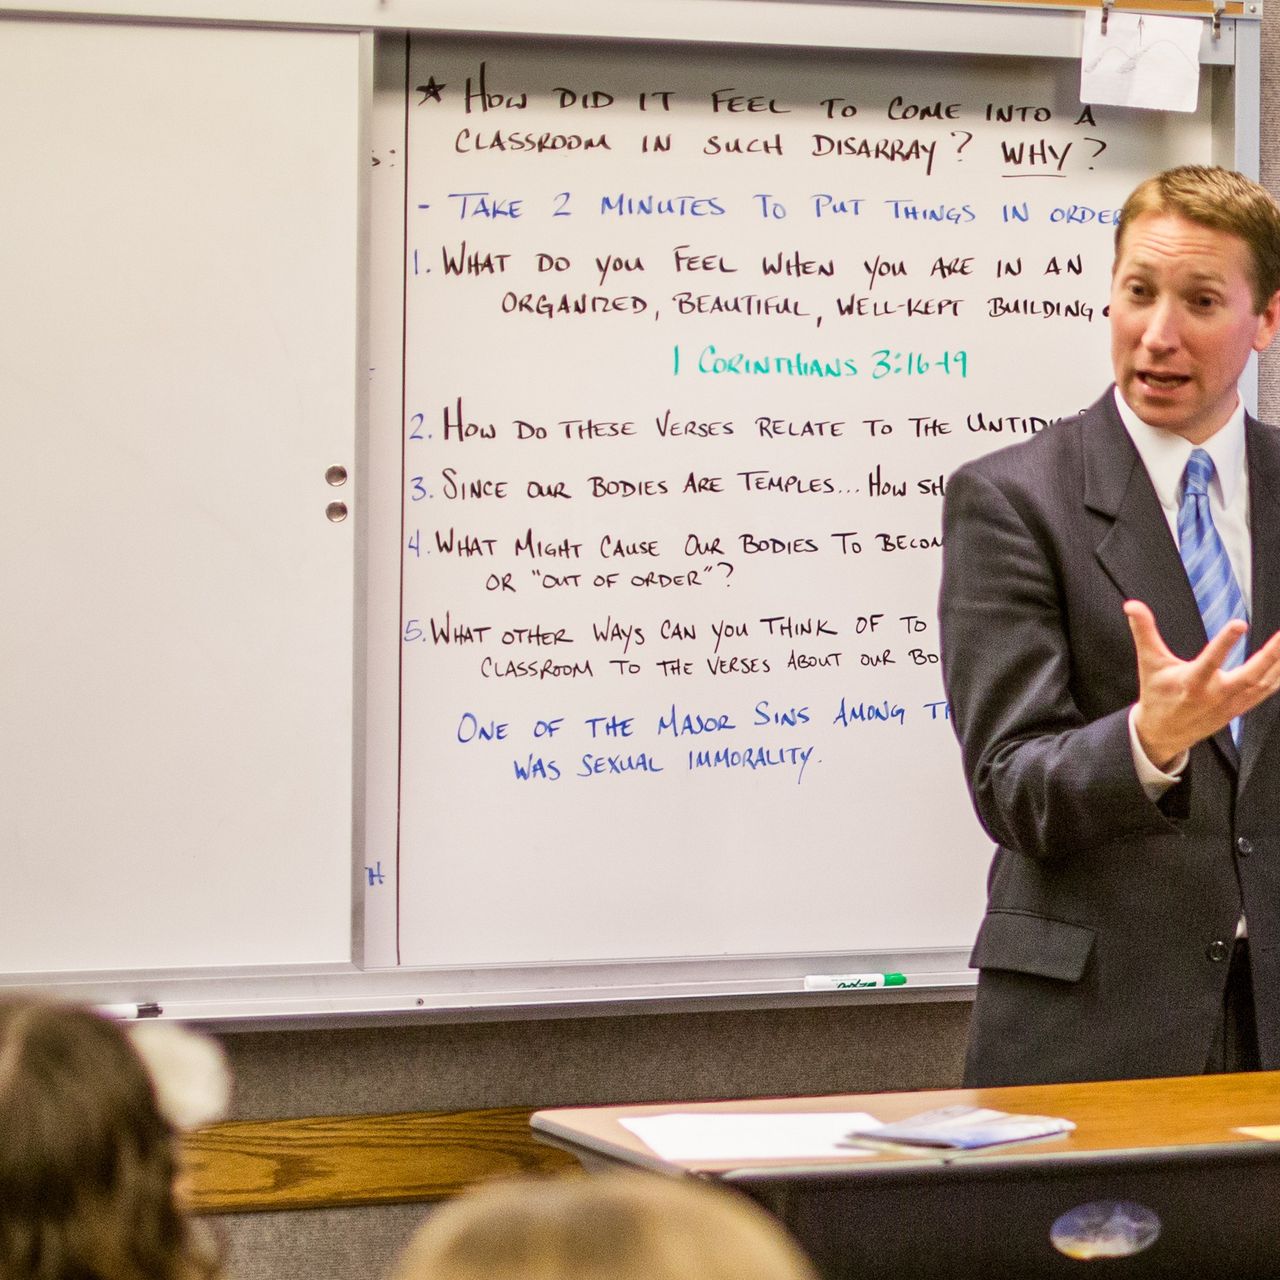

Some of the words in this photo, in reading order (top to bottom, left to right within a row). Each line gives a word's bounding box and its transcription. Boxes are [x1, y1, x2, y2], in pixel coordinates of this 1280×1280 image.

[464, 61, 528, 115] HOW
[551, 87, 614, 110] DID
[638, 91, 676, 112] IT
[711, 87, 792, 114] FEEL
[819, 97, 858, 120] TO
[887, 95, 962, 121] COME
[985, 103, 1052, 124] INTO
[1075, 104, 1096, 127] A
[454, 127, 612, 154] CLASSROOM
[641, 133, 672, 154] IN
[702, 133, 784, 156] SUCH
[447, 192, 523, 220] TAKE
[553, 191, 572, 217] 2
[600, 192, 726, 217] MINUTES
[753, 194, 786, 220] TO
[812, 193, 865, 218] PUT
[884, 200, 976, 225] THINGS
[1002, 202, 1030, 223] IN
[1049, 205, 1121, 226] ORDER
[441, 239, 512, 277] WHAT
[535, 252, 571, 273] DO
[594, 254, 645, 287] YOU
[672, 244, 738, 274] FEEL
[761, 250, 835, 279] WHEN
[863, 254, 908, 292] YOU
[929, 256, 976, 280] ARE
[996, 256, 1023, 279] IN
[1043, 253, 1083, 276] AN
[501, 291, 660, 322] ORGANIZED,
[671, 291, 823, 329] BEAUTIFUL,
[835, 292, 965, 318] WELL-KEPT
[697, 344, 858, 379] CORINTHIANS
[871, 348, 968, 380] 3:16-19
[409, 412, 433, 440] 2.
[443, 396, 497, 443] HOW
[511, 419, 548, 440] DO
[557, 418, 638, 440] THESE
[655, 408, 735, 438] VERSES
[754, 416, 846, 440] RELATE
[861, 418, 893, 438] TO
[907, 416, 953, 438] THE
[410, 475, 434, 502] 3.
[441, 467, 509, 501] SINCE
[526, 480, 573, 500] OUR
[586, 475, 669, 499] BODIES
[682, 471, 725, 494] ARE
[868, 463, 907, 498] HOW
[408, 529, 431, 558] 4.
[434, 526, 498, 558] WHAT
[514, 527, 583, 560] MIGHT
[599, 534, 661, 559] CAUSE
[684, 533, 726, 557] OUR
[737, 533, 820, 556] BODIES
[830, 531, 863, 555] TO
[485, 572, 517, 593] OR
[592, 572, 620, 589] OF
[403, 619, 427, 643] 5.
[429, 610, 492, 646] WHAT
[501, 623, 575, 647] OTHER
[592, 615, 646, 655] WAYS
[660, 618, 697, 641] CAN
[711, 619, 749, 655] YOU
[759, 615, 839, 639] THINK
[855, 613, 885, 635] OF
[898, 615, 928, 635] TO
[480, 656, 594, 681] CLASSROOM
[608, 659, 641, 676] TO
[655, 657, 694, 678] THE
[706, 655, 771, 676] VERSES
[786, 648, 843, 671] ABOUT
[860, 648, 897, 668] OUR
[457, 712, 509, 744] ONE
[533, 717, 565, 738] OF
[584, 714, 635, 739] THE
[657, 703, 737, 738] MAJOR
[753, 700, 811, 727] SINS
[832, 696, 906, 728] AMONG
[513, 752, 561, 781] WAS
[576, 752, 665, 778] SEXUAL
[688, 745, 823, 785] IMMORALITY.
